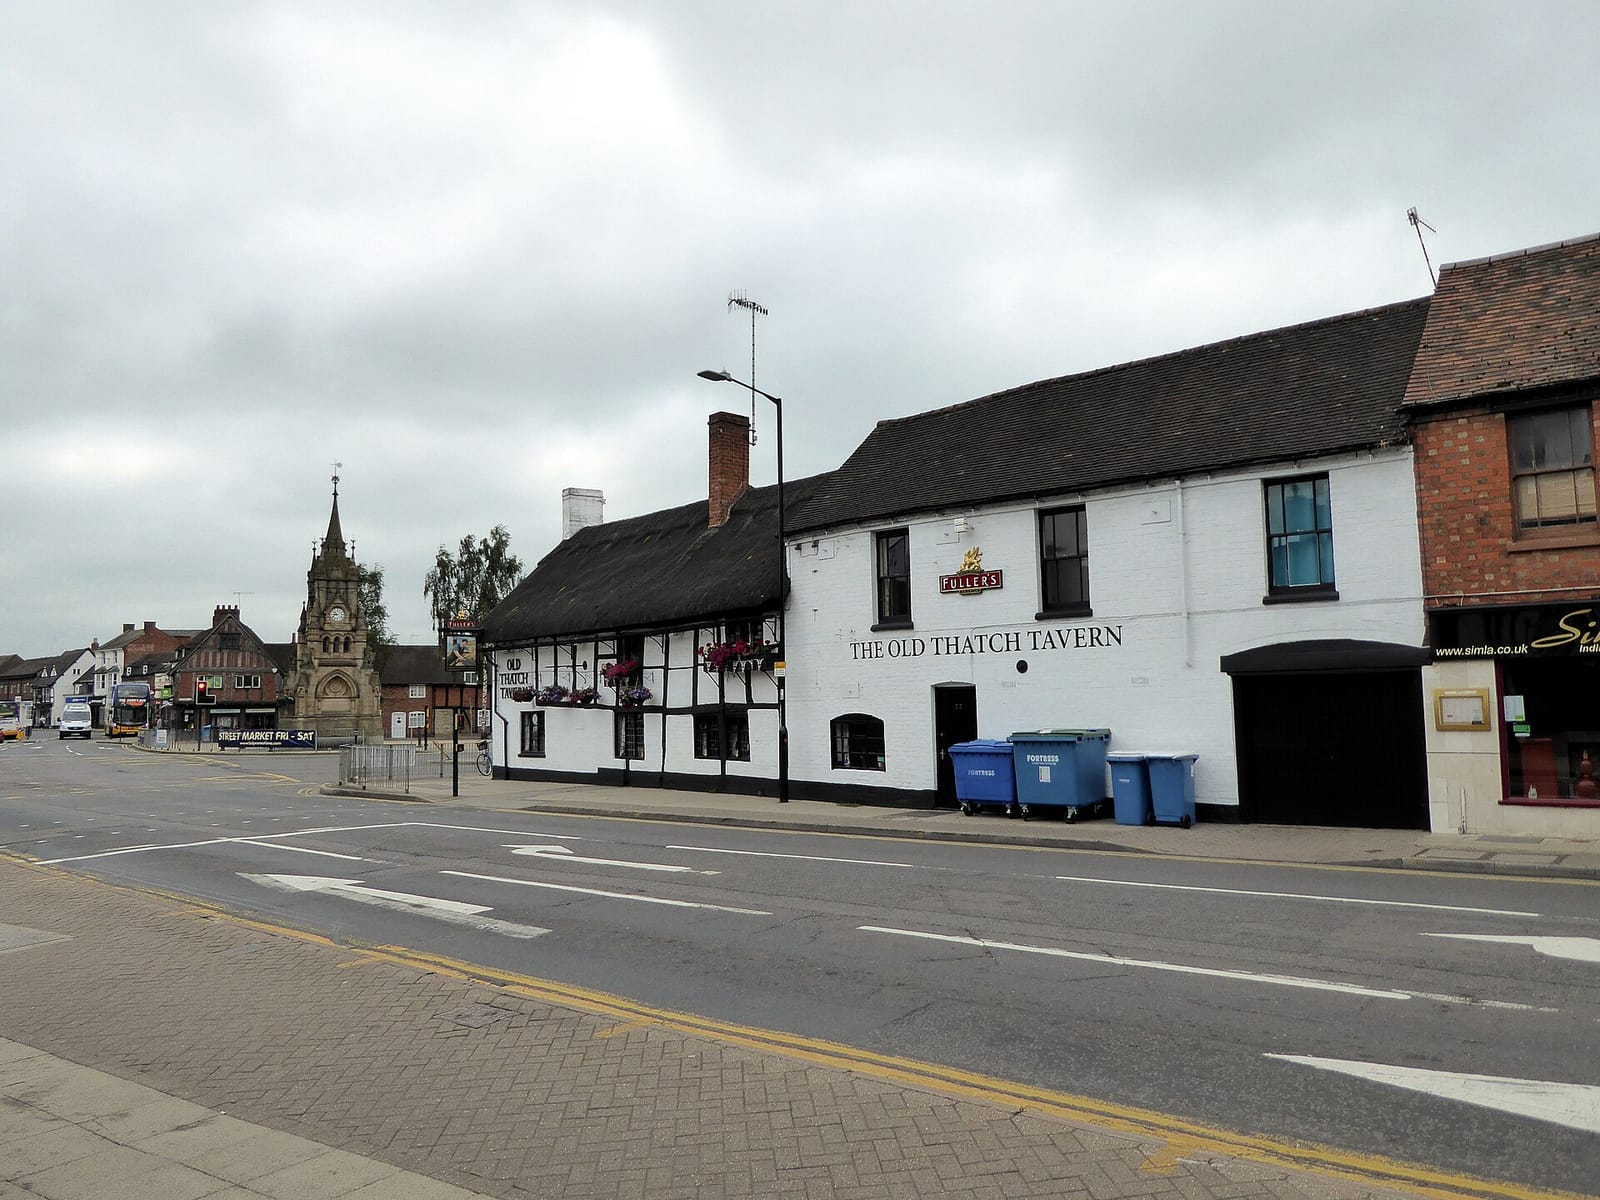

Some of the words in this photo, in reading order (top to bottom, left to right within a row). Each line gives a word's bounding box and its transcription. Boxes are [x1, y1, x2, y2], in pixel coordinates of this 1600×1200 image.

[943, 572, 997, 590] FULLER'S
[850, 641, 884, 660] THE
[888, 638, 926, 658] OLD
[931, 632, 1021, 656] THATCH
[1027, 625, 1123, 651] TAVERN
[1579, 643, 1600, 653] Indi
[1436, 643, 1528, 656] www.simla.co.uk
[506, 658, 521, 671] OLD
[499, 672, 528, 685] THATCH
[218, 732, 241, 741] STREET
[241, 731, 274, 741] MARKET
[275, 731, 289, 741] FRI
[297, 731, 314, 741] SAT
[1026, 754, 1060, 762] FORTRESS
[968, 769, 996, 777] FORTRESS
